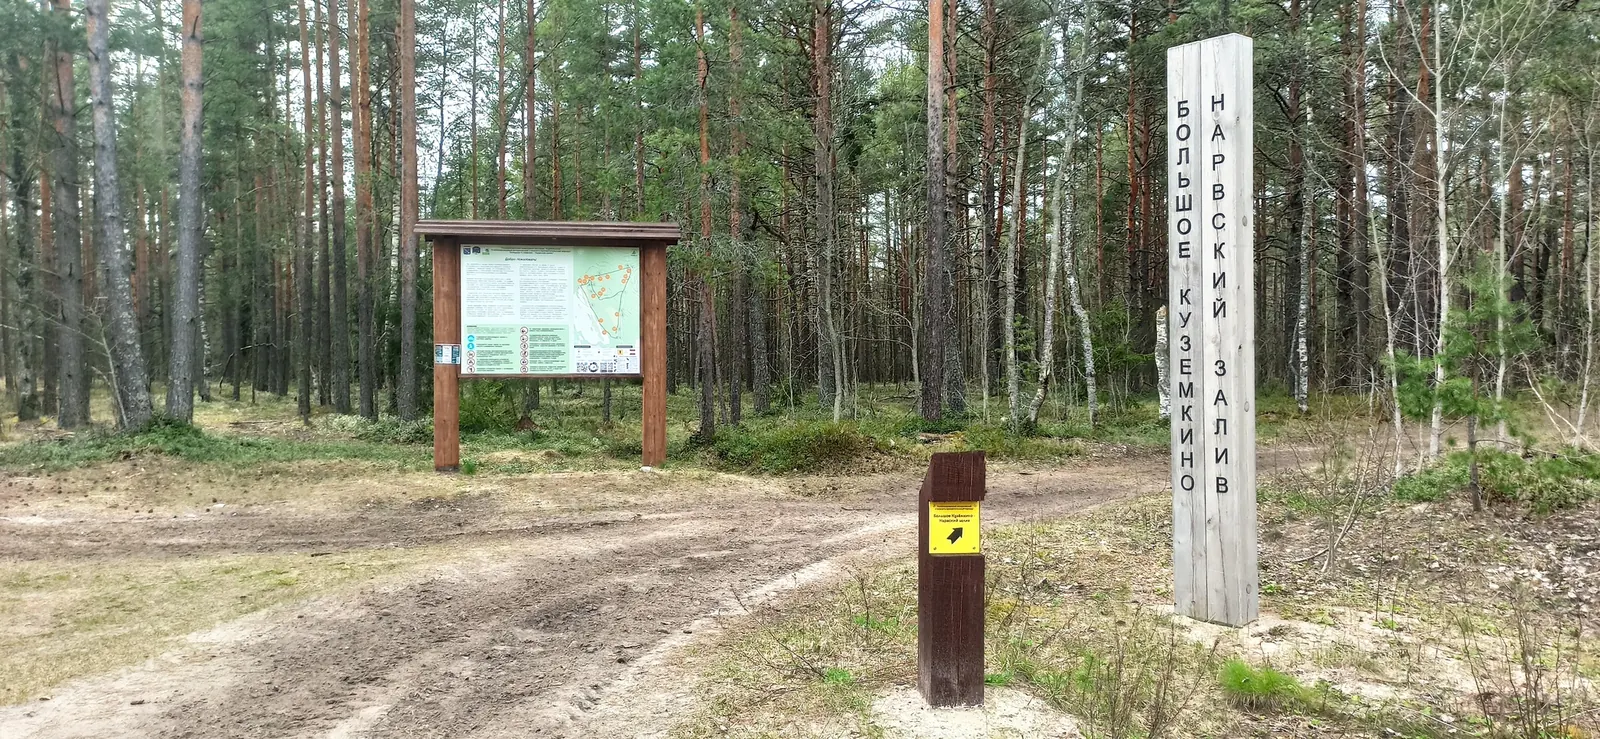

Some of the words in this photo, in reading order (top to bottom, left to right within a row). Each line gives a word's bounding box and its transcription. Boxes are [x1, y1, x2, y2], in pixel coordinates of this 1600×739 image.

[1175, 99, 1193, 259] БОЛЬШОЕ
[1211, 93, 1227, 319] НАРВСКИЙ
[1178, 288, 1195, 491] КУЗЕМКИНО
[1213, 359, 1229, 494] ЗАЛИВ
